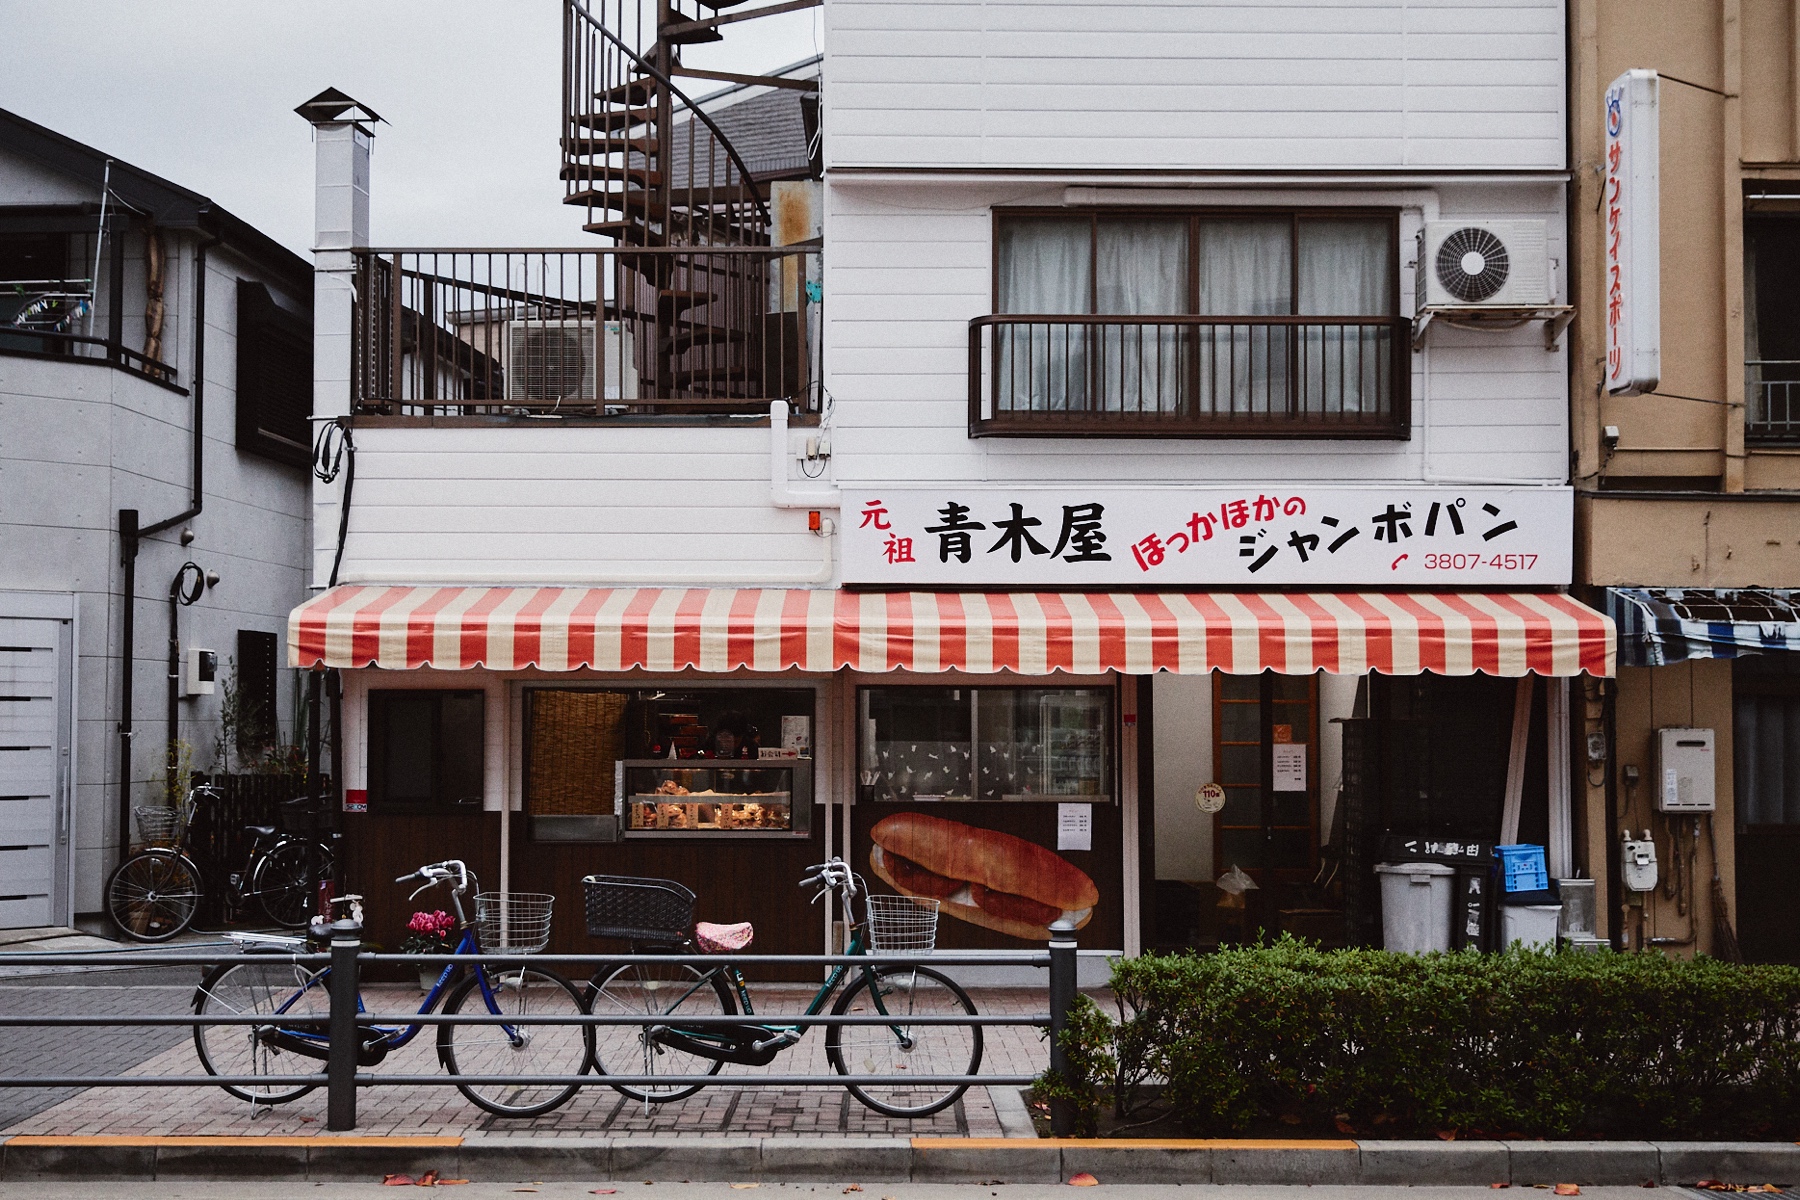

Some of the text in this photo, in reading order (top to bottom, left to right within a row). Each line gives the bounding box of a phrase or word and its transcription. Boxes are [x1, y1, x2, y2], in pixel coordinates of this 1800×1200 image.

[1608, 141, 1622, 380] サンケイスポーツ
[859, 499, 917, 565] 元祖
[924, 501, 1112, 564] 青木屋
[1130, 494, 1307, 572] ほっかほかの
[1239, 497, 1519, 574] ジャンボパン
[1424, 553, 1539, 571] 3807-4517
